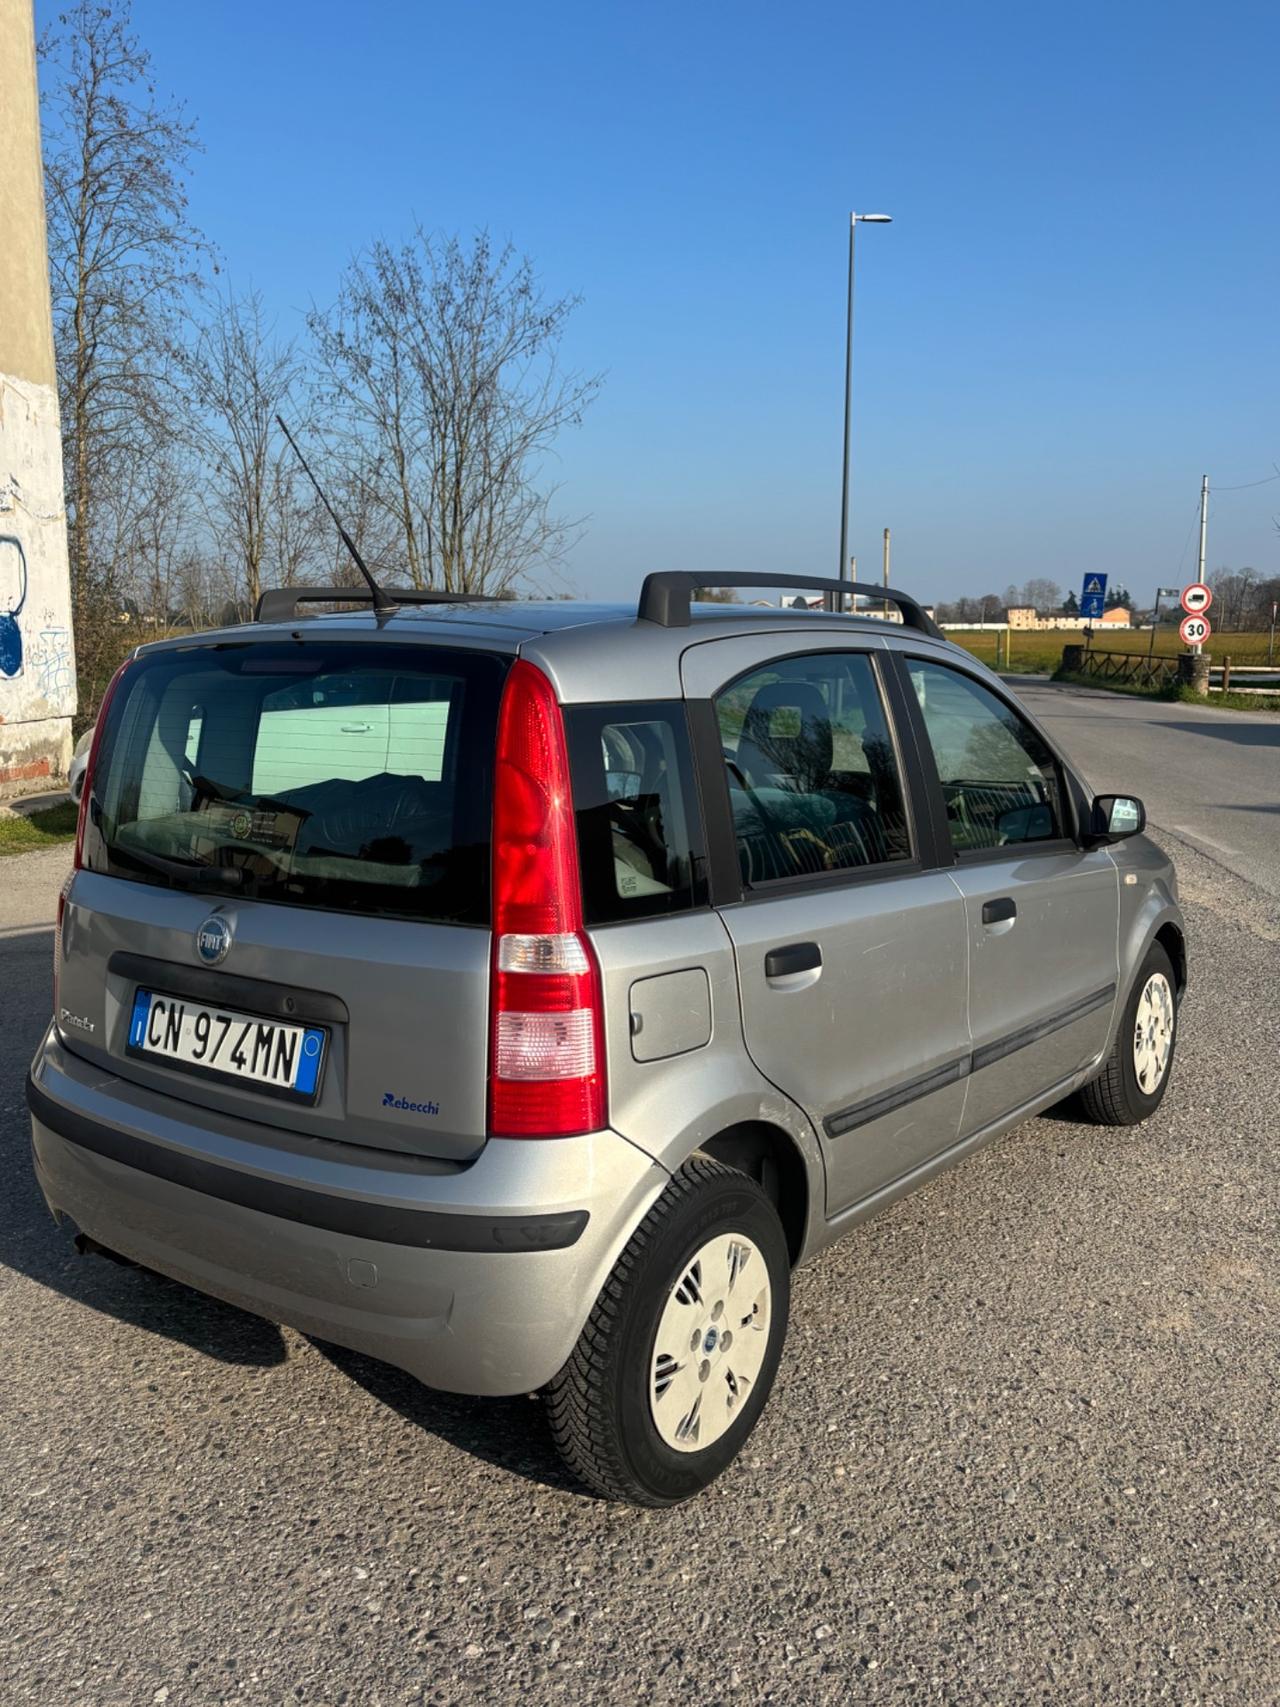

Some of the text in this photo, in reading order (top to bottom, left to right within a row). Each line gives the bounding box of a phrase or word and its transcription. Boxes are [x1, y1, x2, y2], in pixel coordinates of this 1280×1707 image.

[1187, 623, 1204, 637] 30
[200, 932, 223, 951] FIAT
[147, 1000, 298, 1083] CN 974MN
[382, 1092, 440, 1116] Rebecchi
